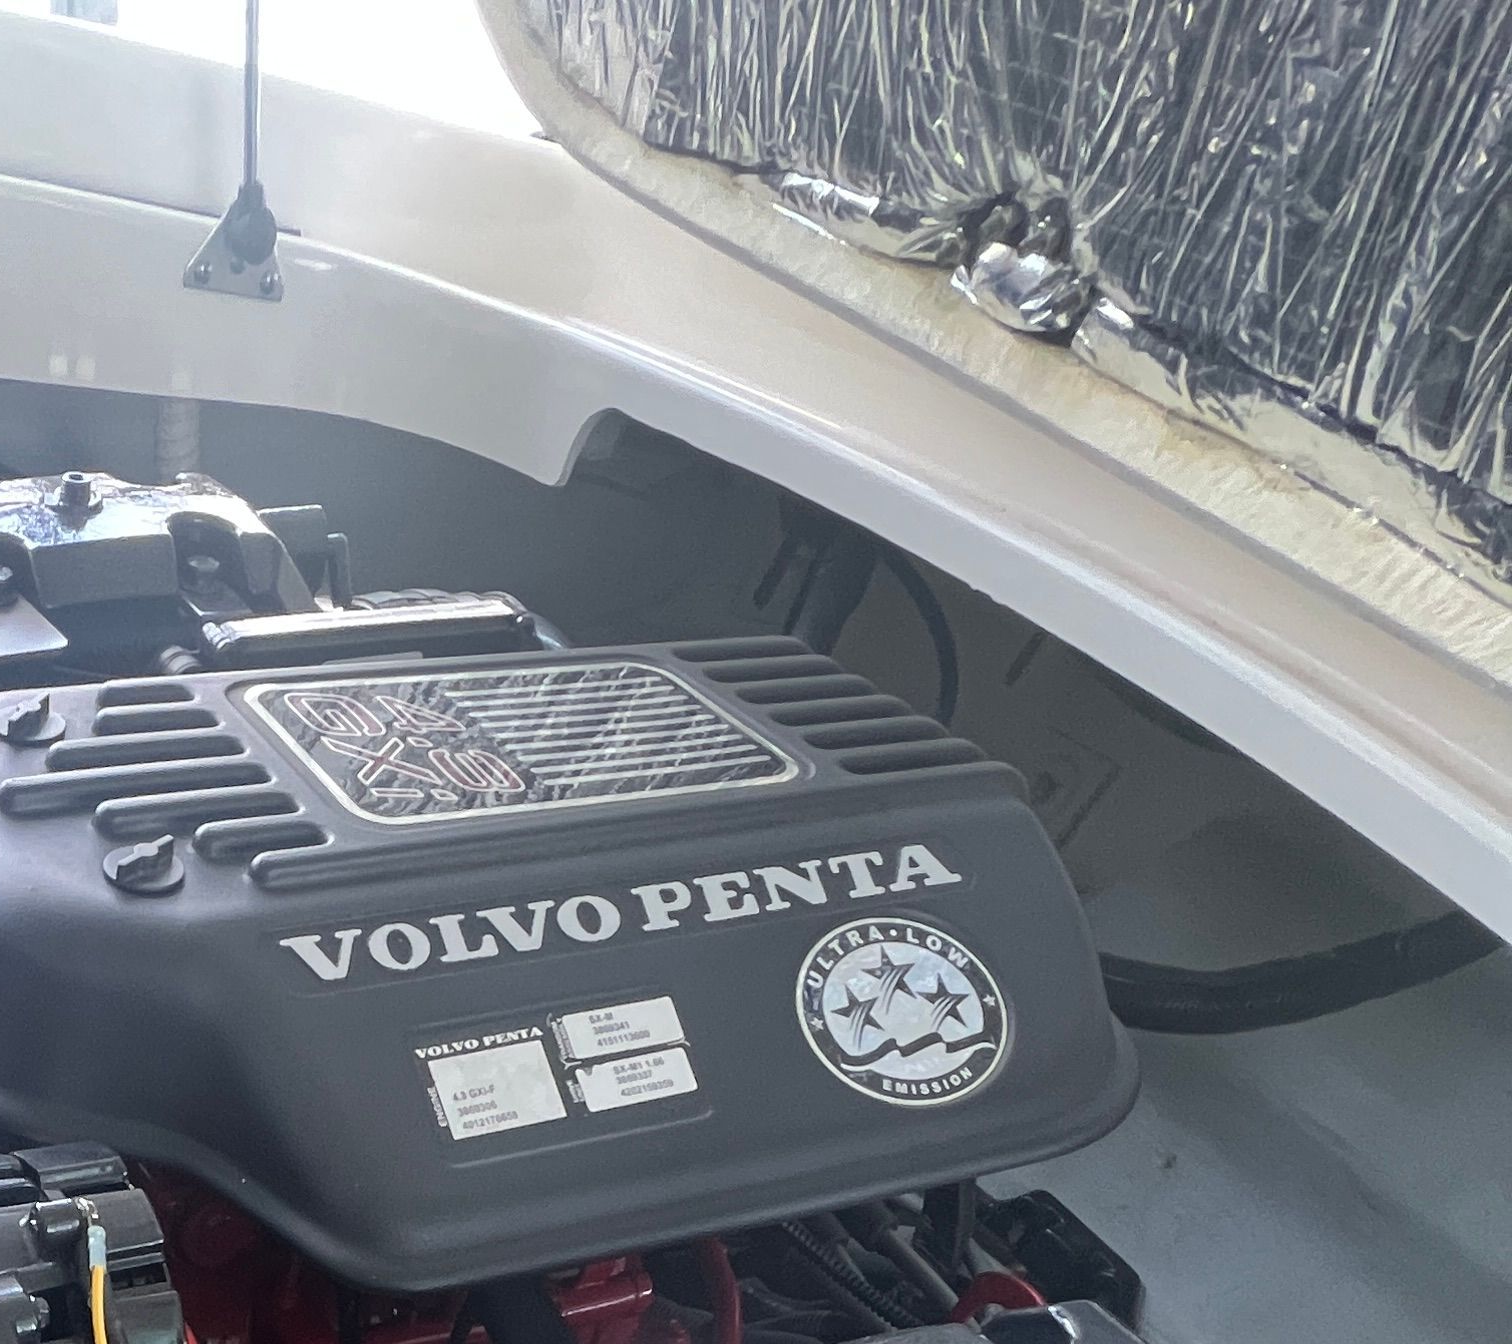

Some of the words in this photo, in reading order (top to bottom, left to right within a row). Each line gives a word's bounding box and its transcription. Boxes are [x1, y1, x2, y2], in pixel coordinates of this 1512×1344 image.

[279, 894, 621, 982] VOLVO
[630, 844, 962, 931] PENTA
[808, 924, 886, 992] ULTRA
[904, 926, 970, 970] LOW
[415, 1039, 479, 1058] VOLVO
[483, 1027, 543, 1046] PENTA
[882, 1065, 974, 1095] EMISSION
